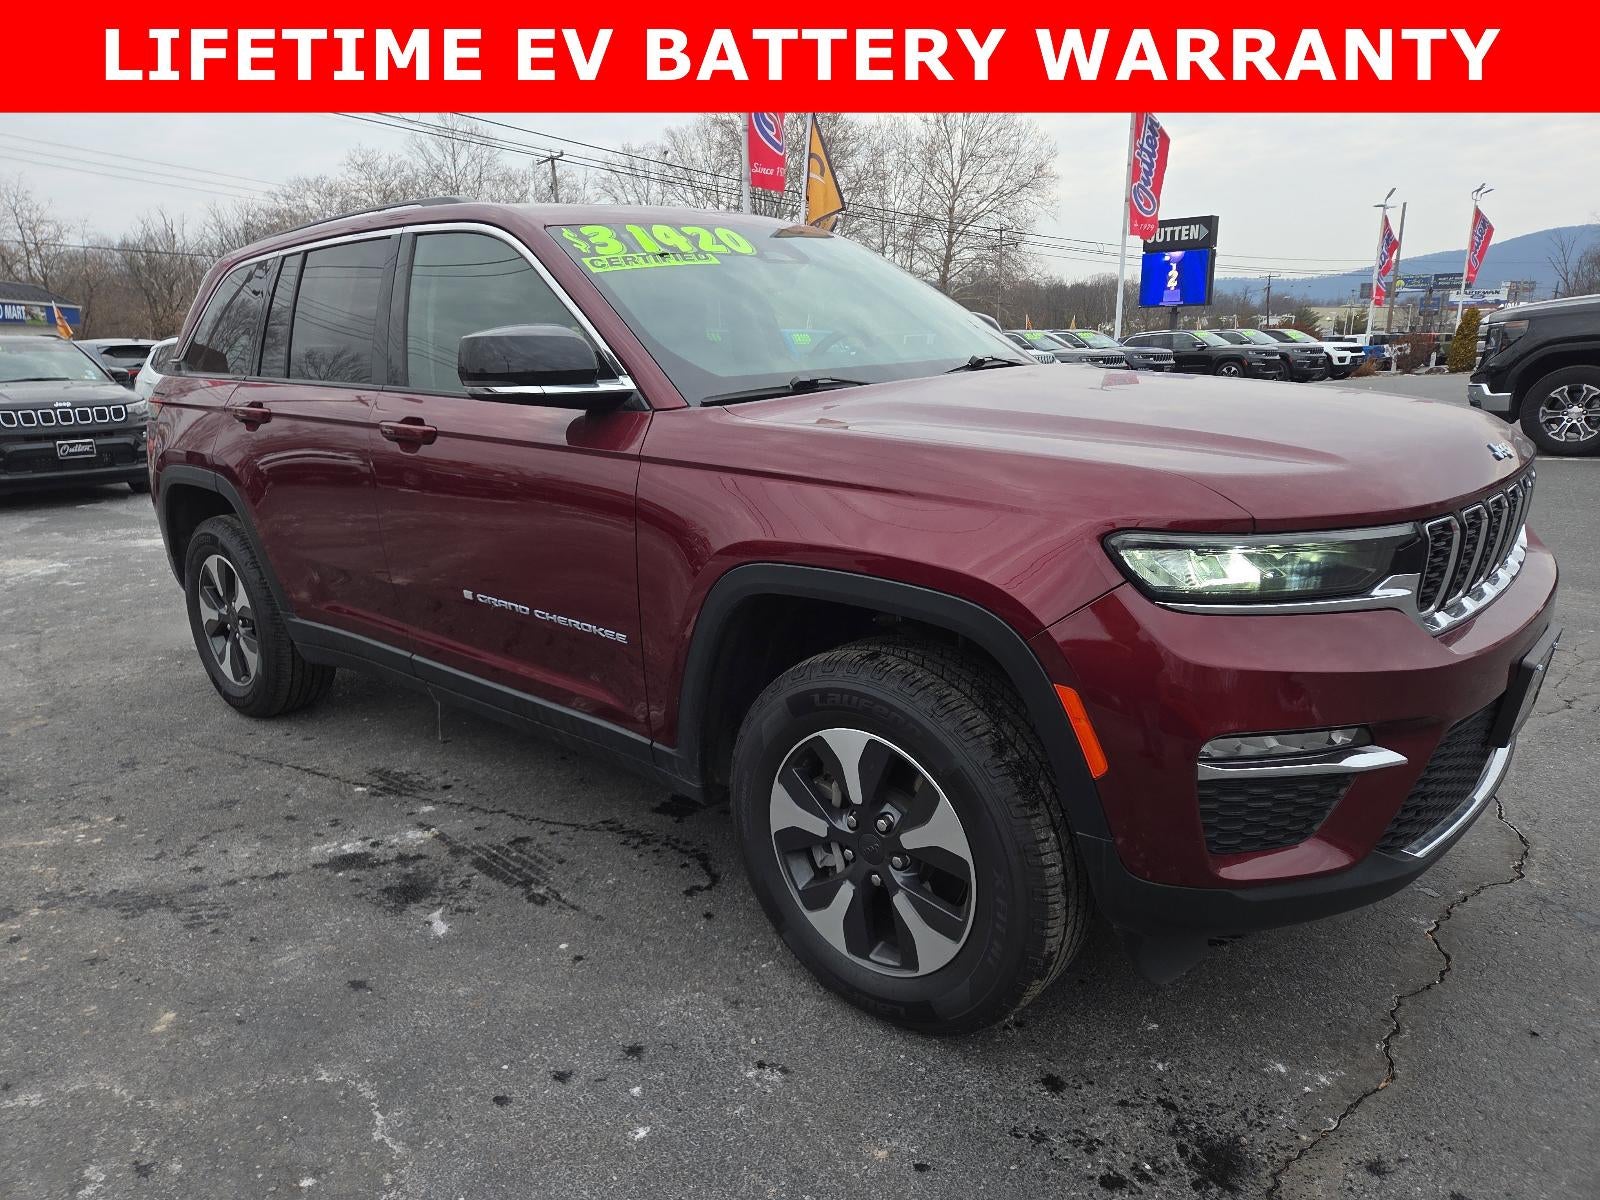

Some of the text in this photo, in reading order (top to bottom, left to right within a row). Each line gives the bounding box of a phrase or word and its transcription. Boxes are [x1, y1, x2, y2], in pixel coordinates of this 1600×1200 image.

[751, 162, 775, 176] Since
[562, 224, 755, 255] $31420
[588, 252, 712, 270] CERTIFIED
[4, 304, 26, 321] MART
[53, 400, 72, 408] Jeep
[476, 593, 628, 644] GRAND CHEROKEE
